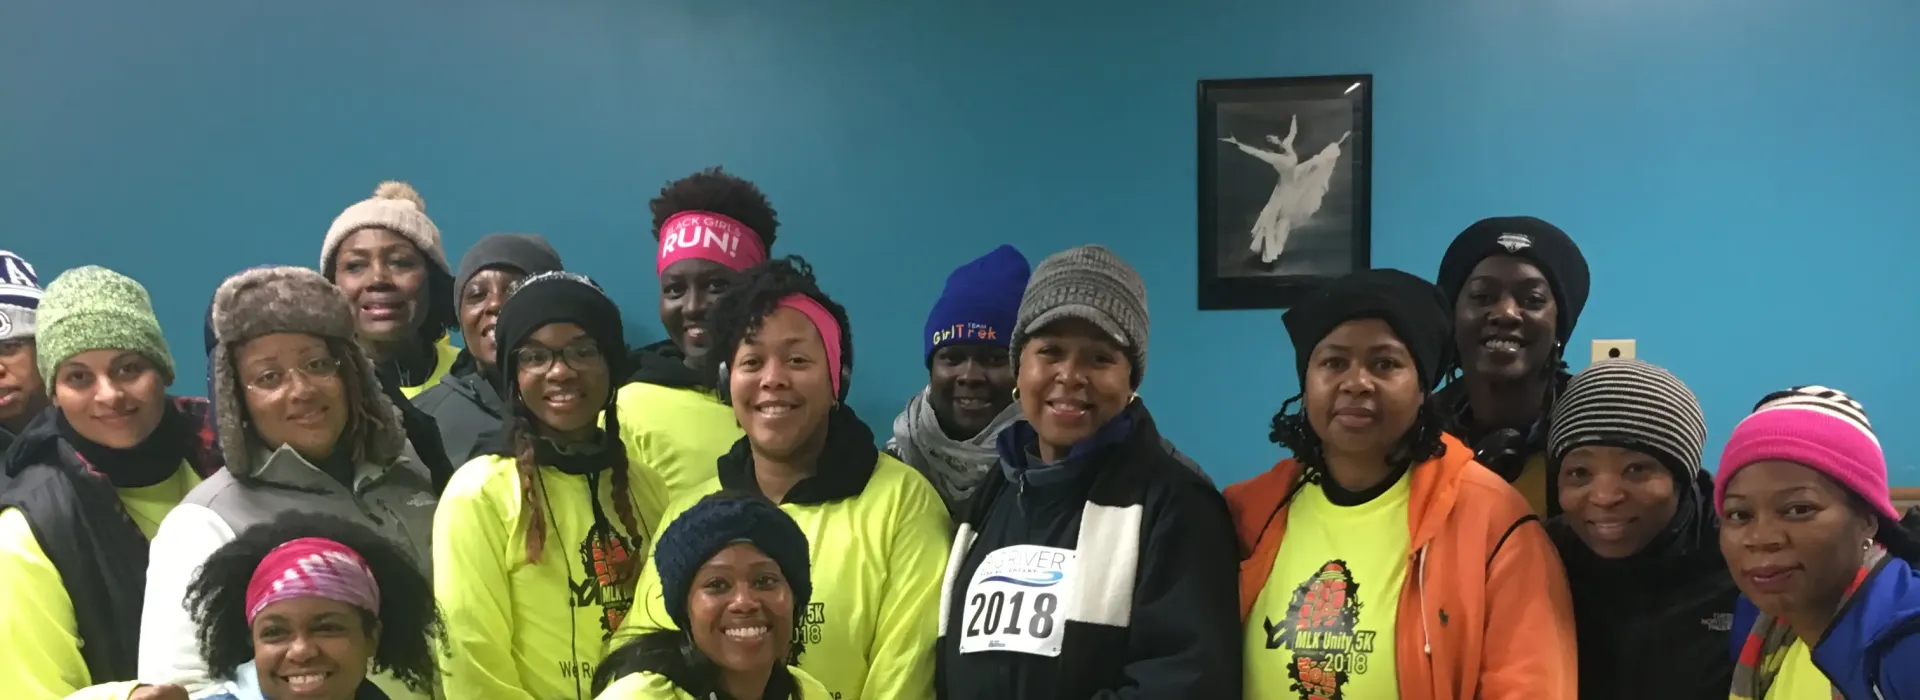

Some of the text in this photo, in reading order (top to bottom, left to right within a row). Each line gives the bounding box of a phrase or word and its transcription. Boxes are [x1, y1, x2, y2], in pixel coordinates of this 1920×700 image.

[666, 217, 741, 237] BLACK GIRLS
[662, 226, 741, 258] RUN!
[807, 602, 825, 624] 5K
[966, 590, 1058, 639] 2018
[1294, 631, 1375, 653] MLK Unity 5K
[1323, 653, 1368, 674] 2018
